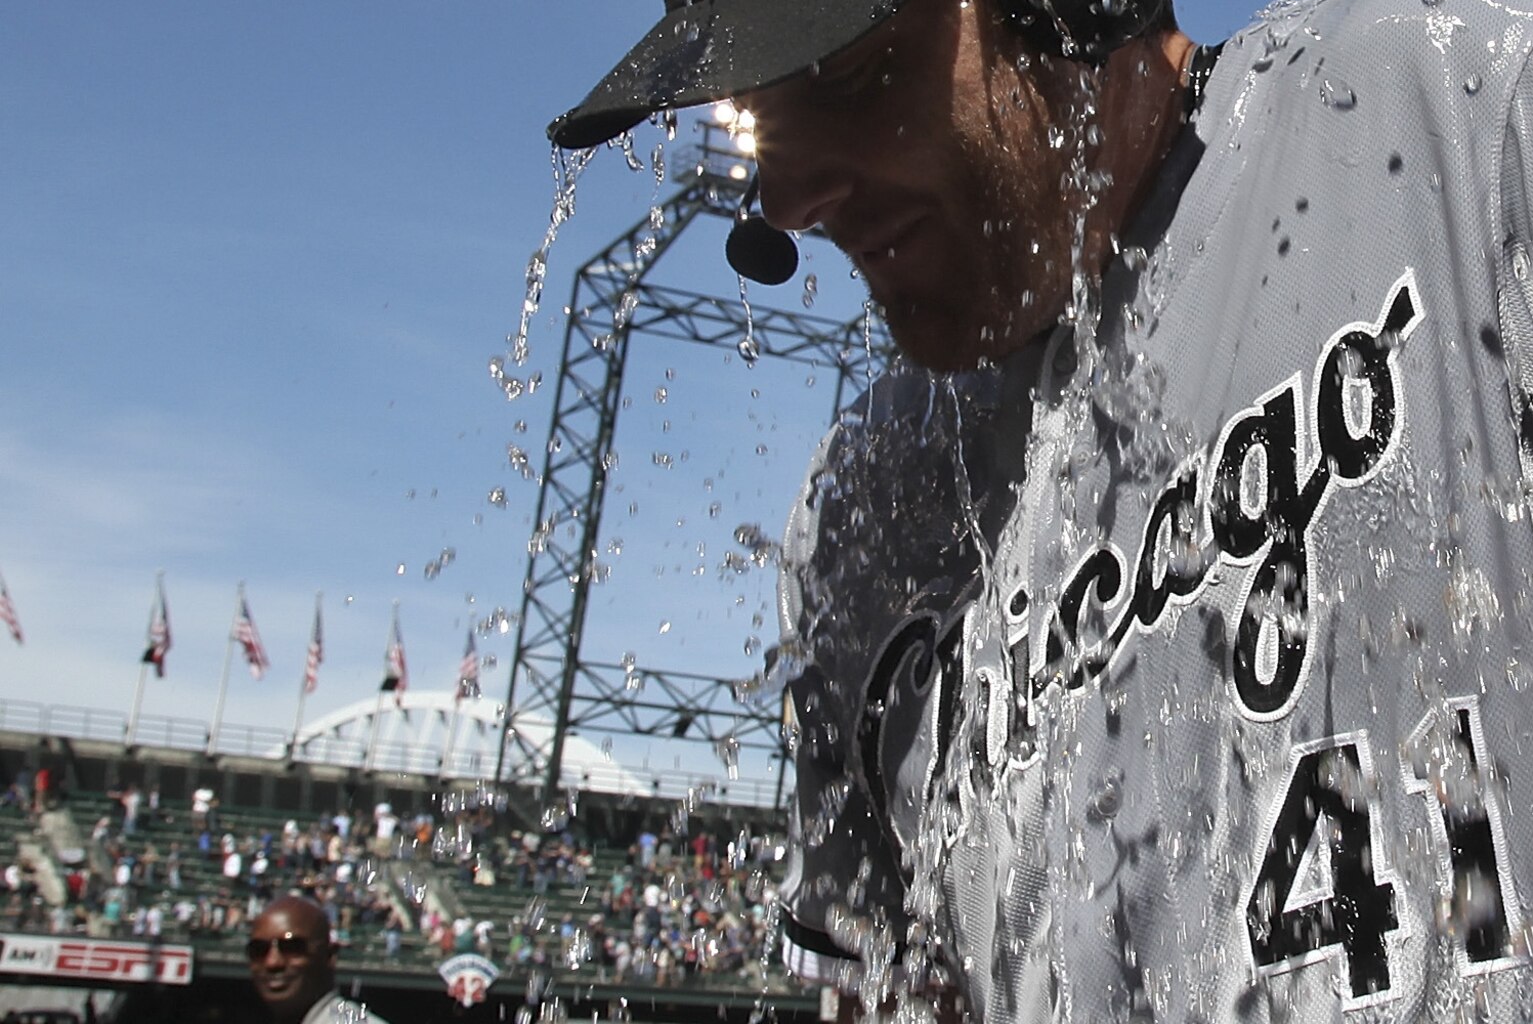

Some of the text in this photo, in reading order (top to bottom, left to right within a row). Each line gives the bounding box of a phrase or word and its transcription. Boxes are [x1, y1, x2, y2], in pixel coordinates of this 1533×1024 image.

[856, 266, 1426, 886] Chicago
[56, 943, 189, 977] ESPN
[1237, 694, 1530, 1012] 41
